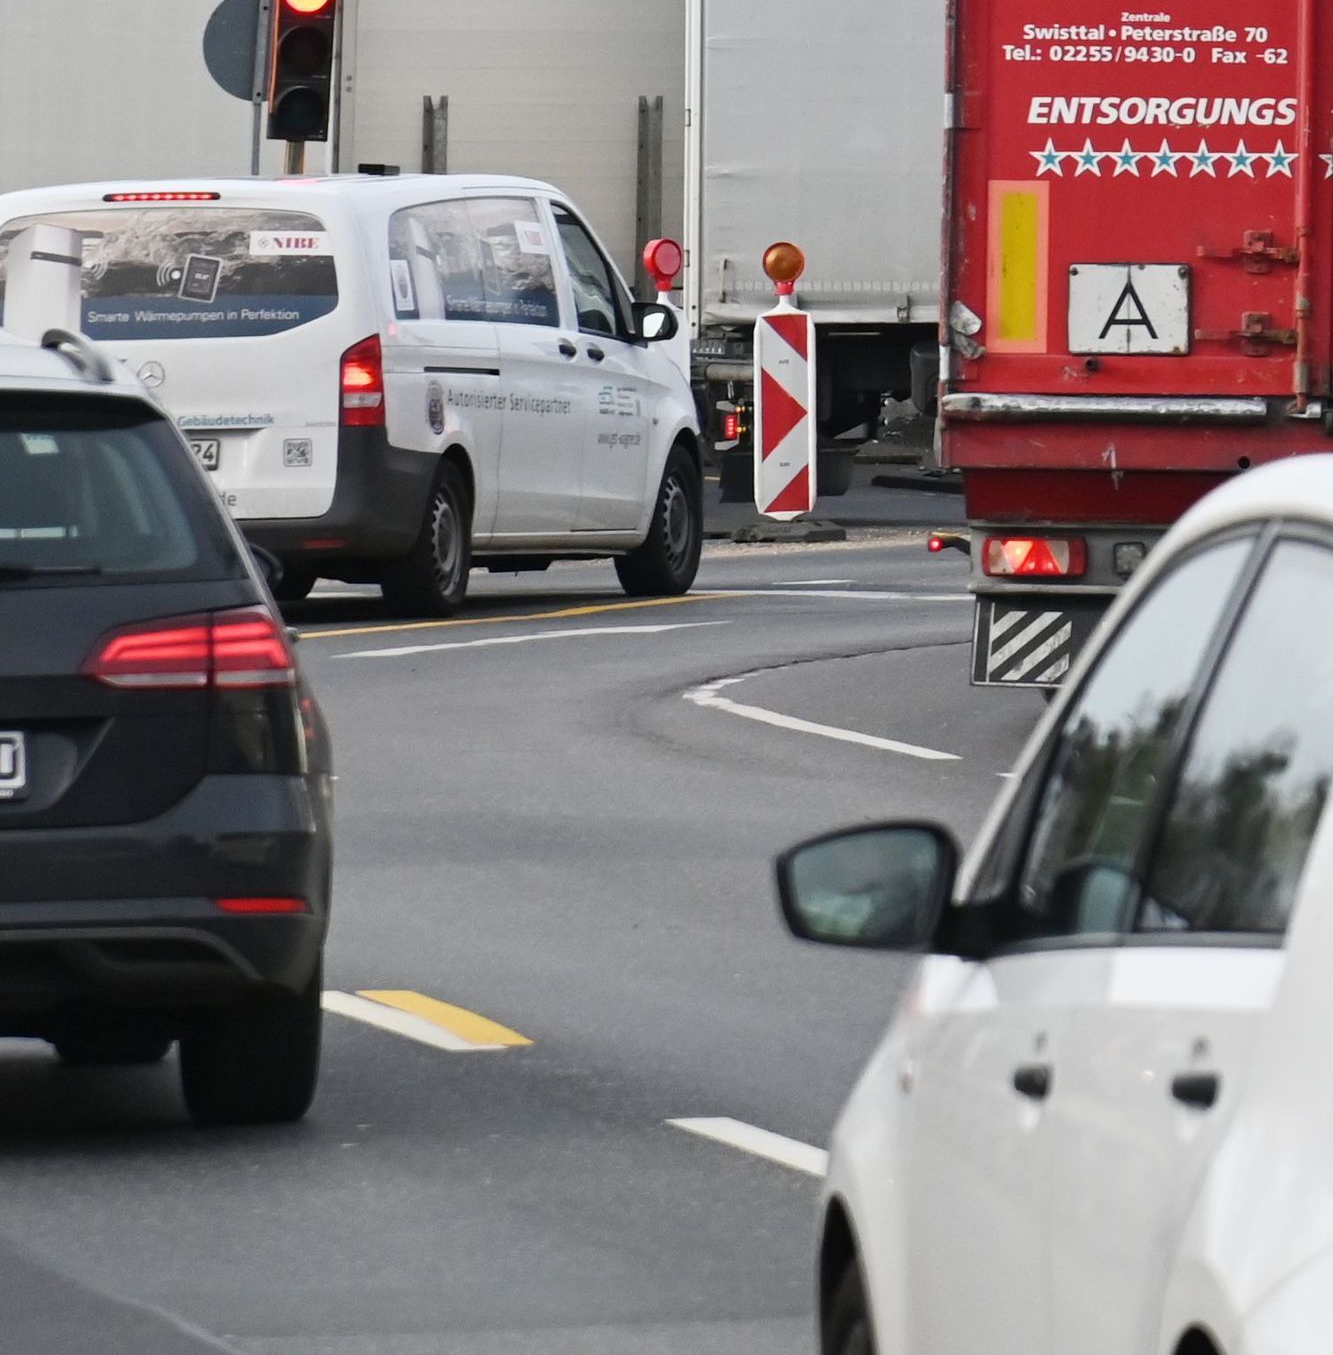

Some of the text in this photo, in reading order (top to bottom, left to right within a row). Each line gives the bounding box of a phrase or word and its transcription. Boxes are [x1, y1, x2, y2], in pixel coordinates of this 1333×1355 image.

[1120, 12, 1170, 22] Zentrale
[1023, 24, 1268, 43] Swisttal Peterstraße 70
[1002, 44, 1288, 64] Tel.: 02255/9430-0 Fax -62
[1027, 97, 1298, 126] ENTSORGUNGS
[273, 237, 319, 249] NIBE
[87, 309, 299, 323] Smarte Wärmepumpen in Perfektion
[1099, 281, 1158, 340] A
[447, 389, 571, 417] Autorisierter Servicepartner
[177, 414, 275, 427] Gebäudetechnik
